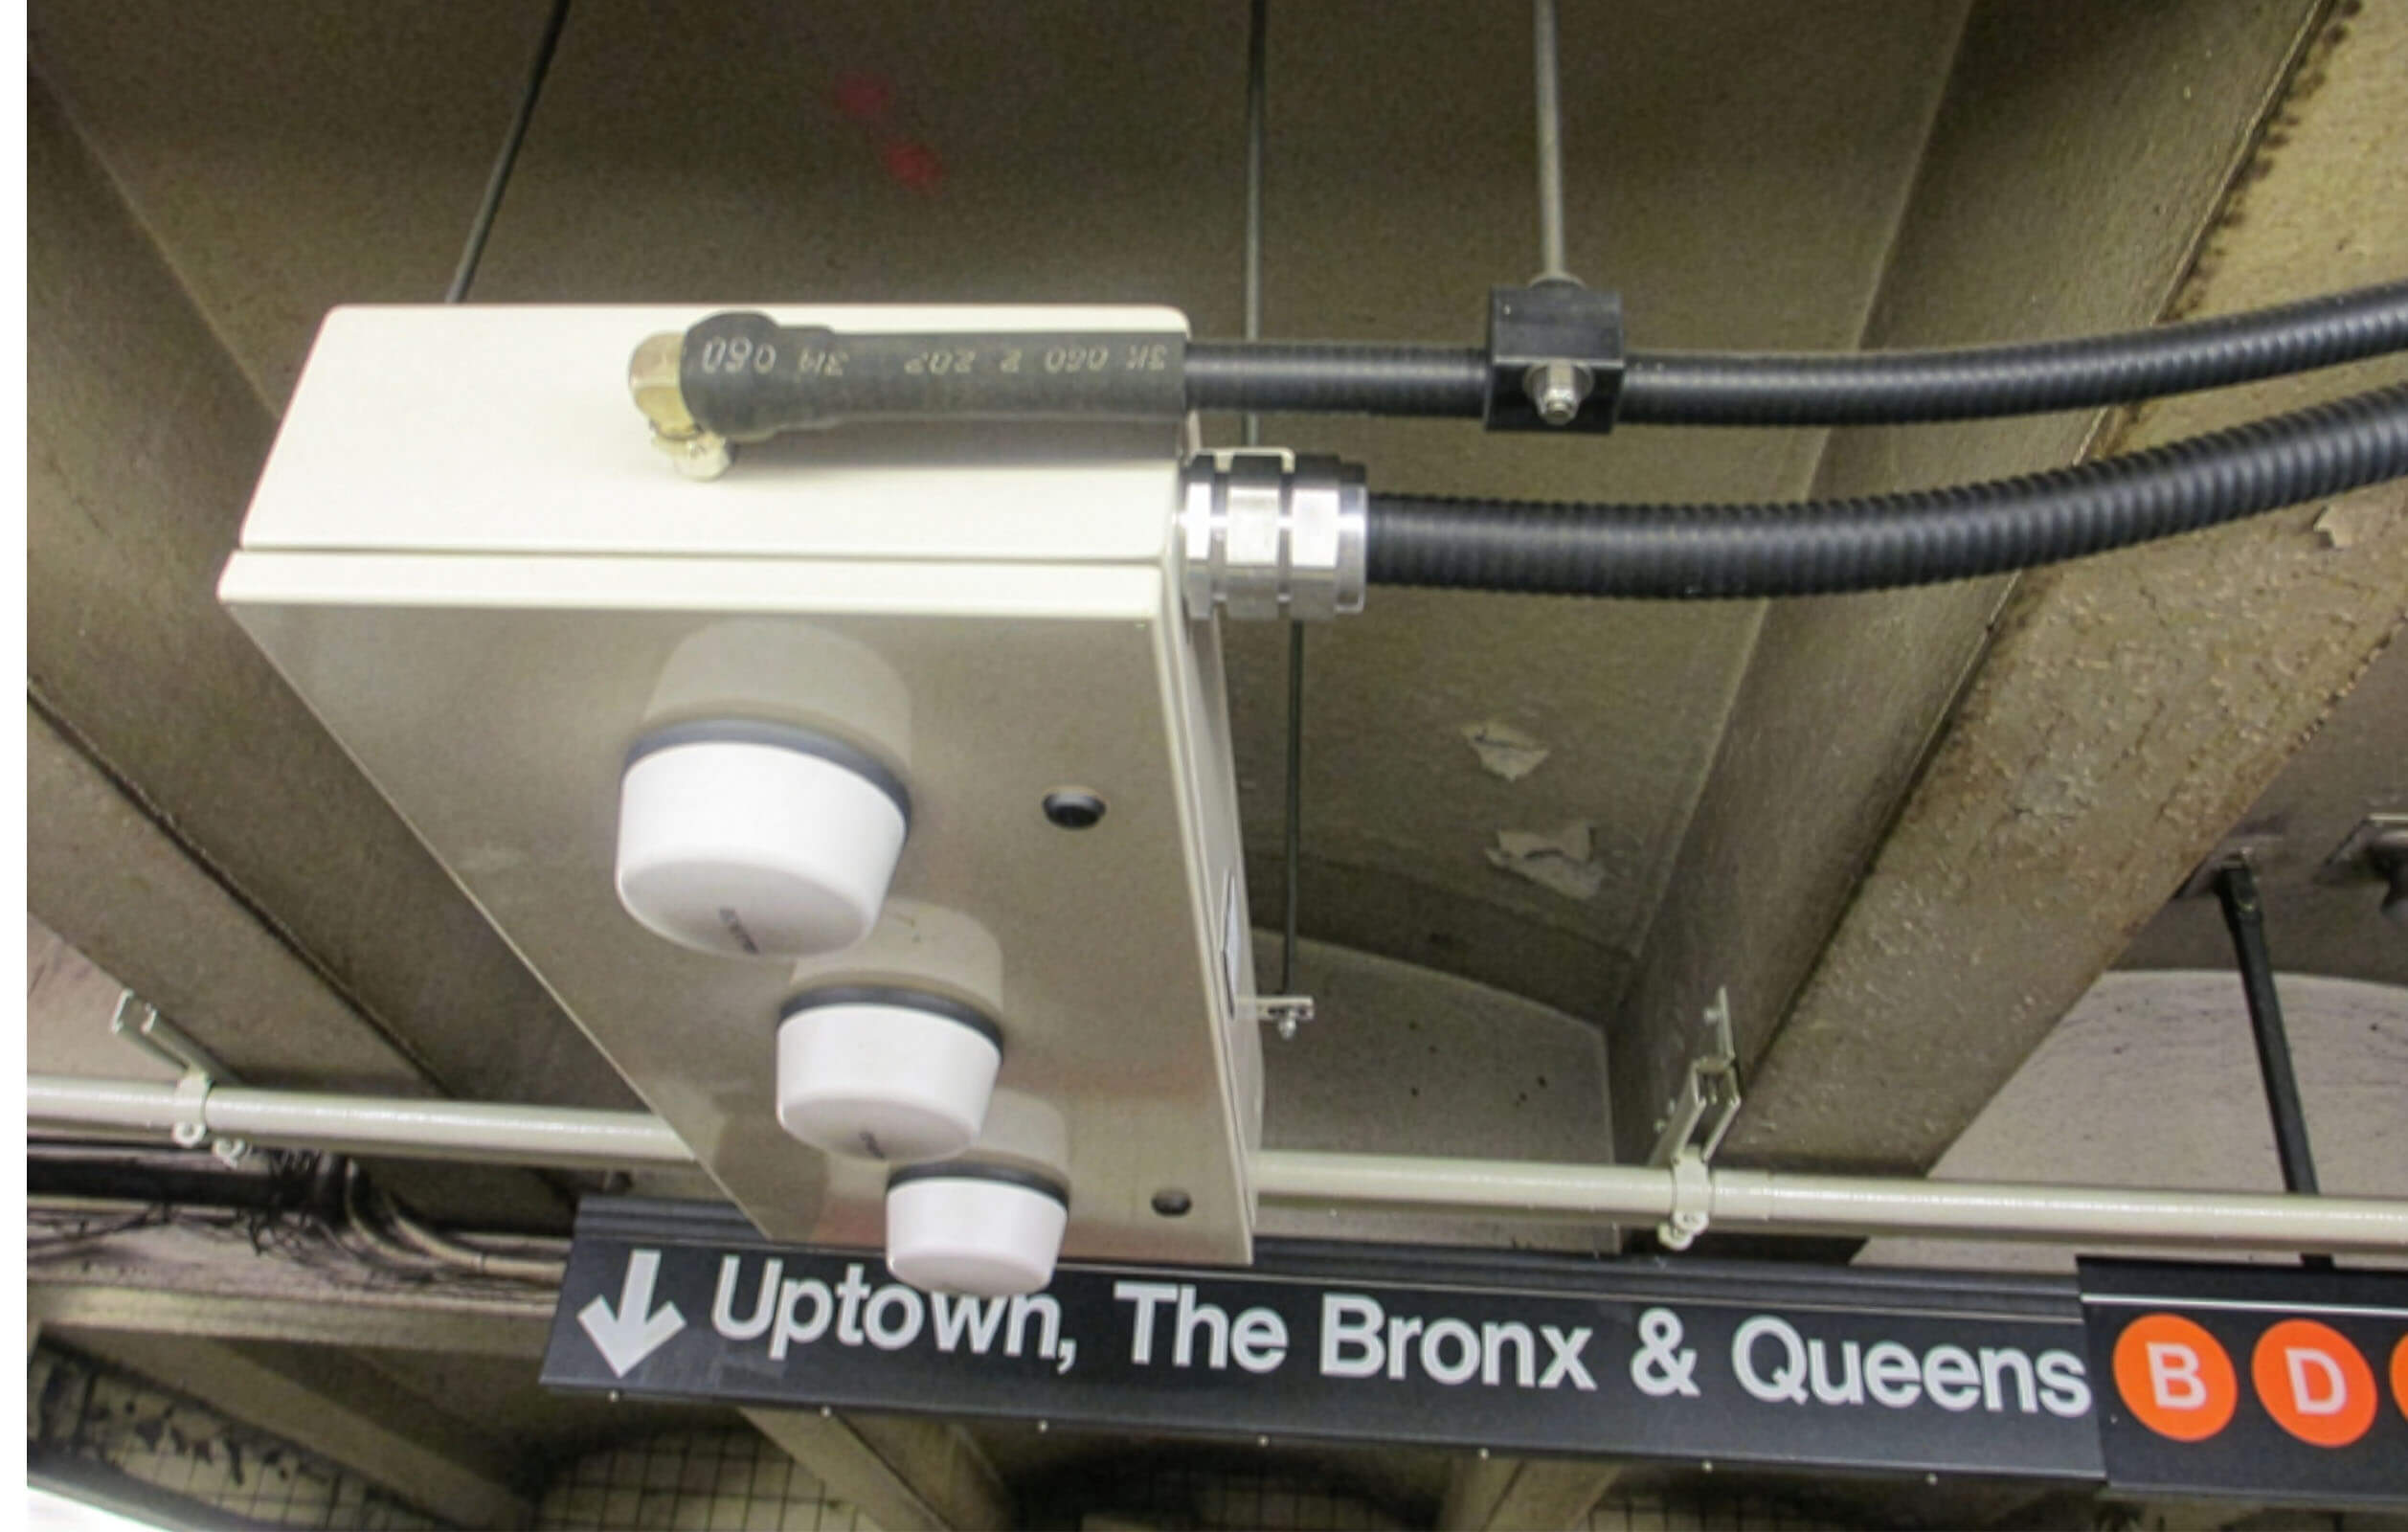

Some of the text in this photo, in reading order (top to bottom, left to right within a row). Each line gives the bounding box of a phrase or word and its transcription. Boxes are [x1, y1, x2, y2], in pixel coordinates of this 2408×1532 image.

[701, 335, 776, 374] 060
[710, 1255, 2093, 1417] Uptown, The Bronx & Queens
[2146, 1341, 2349, 1417] B D
